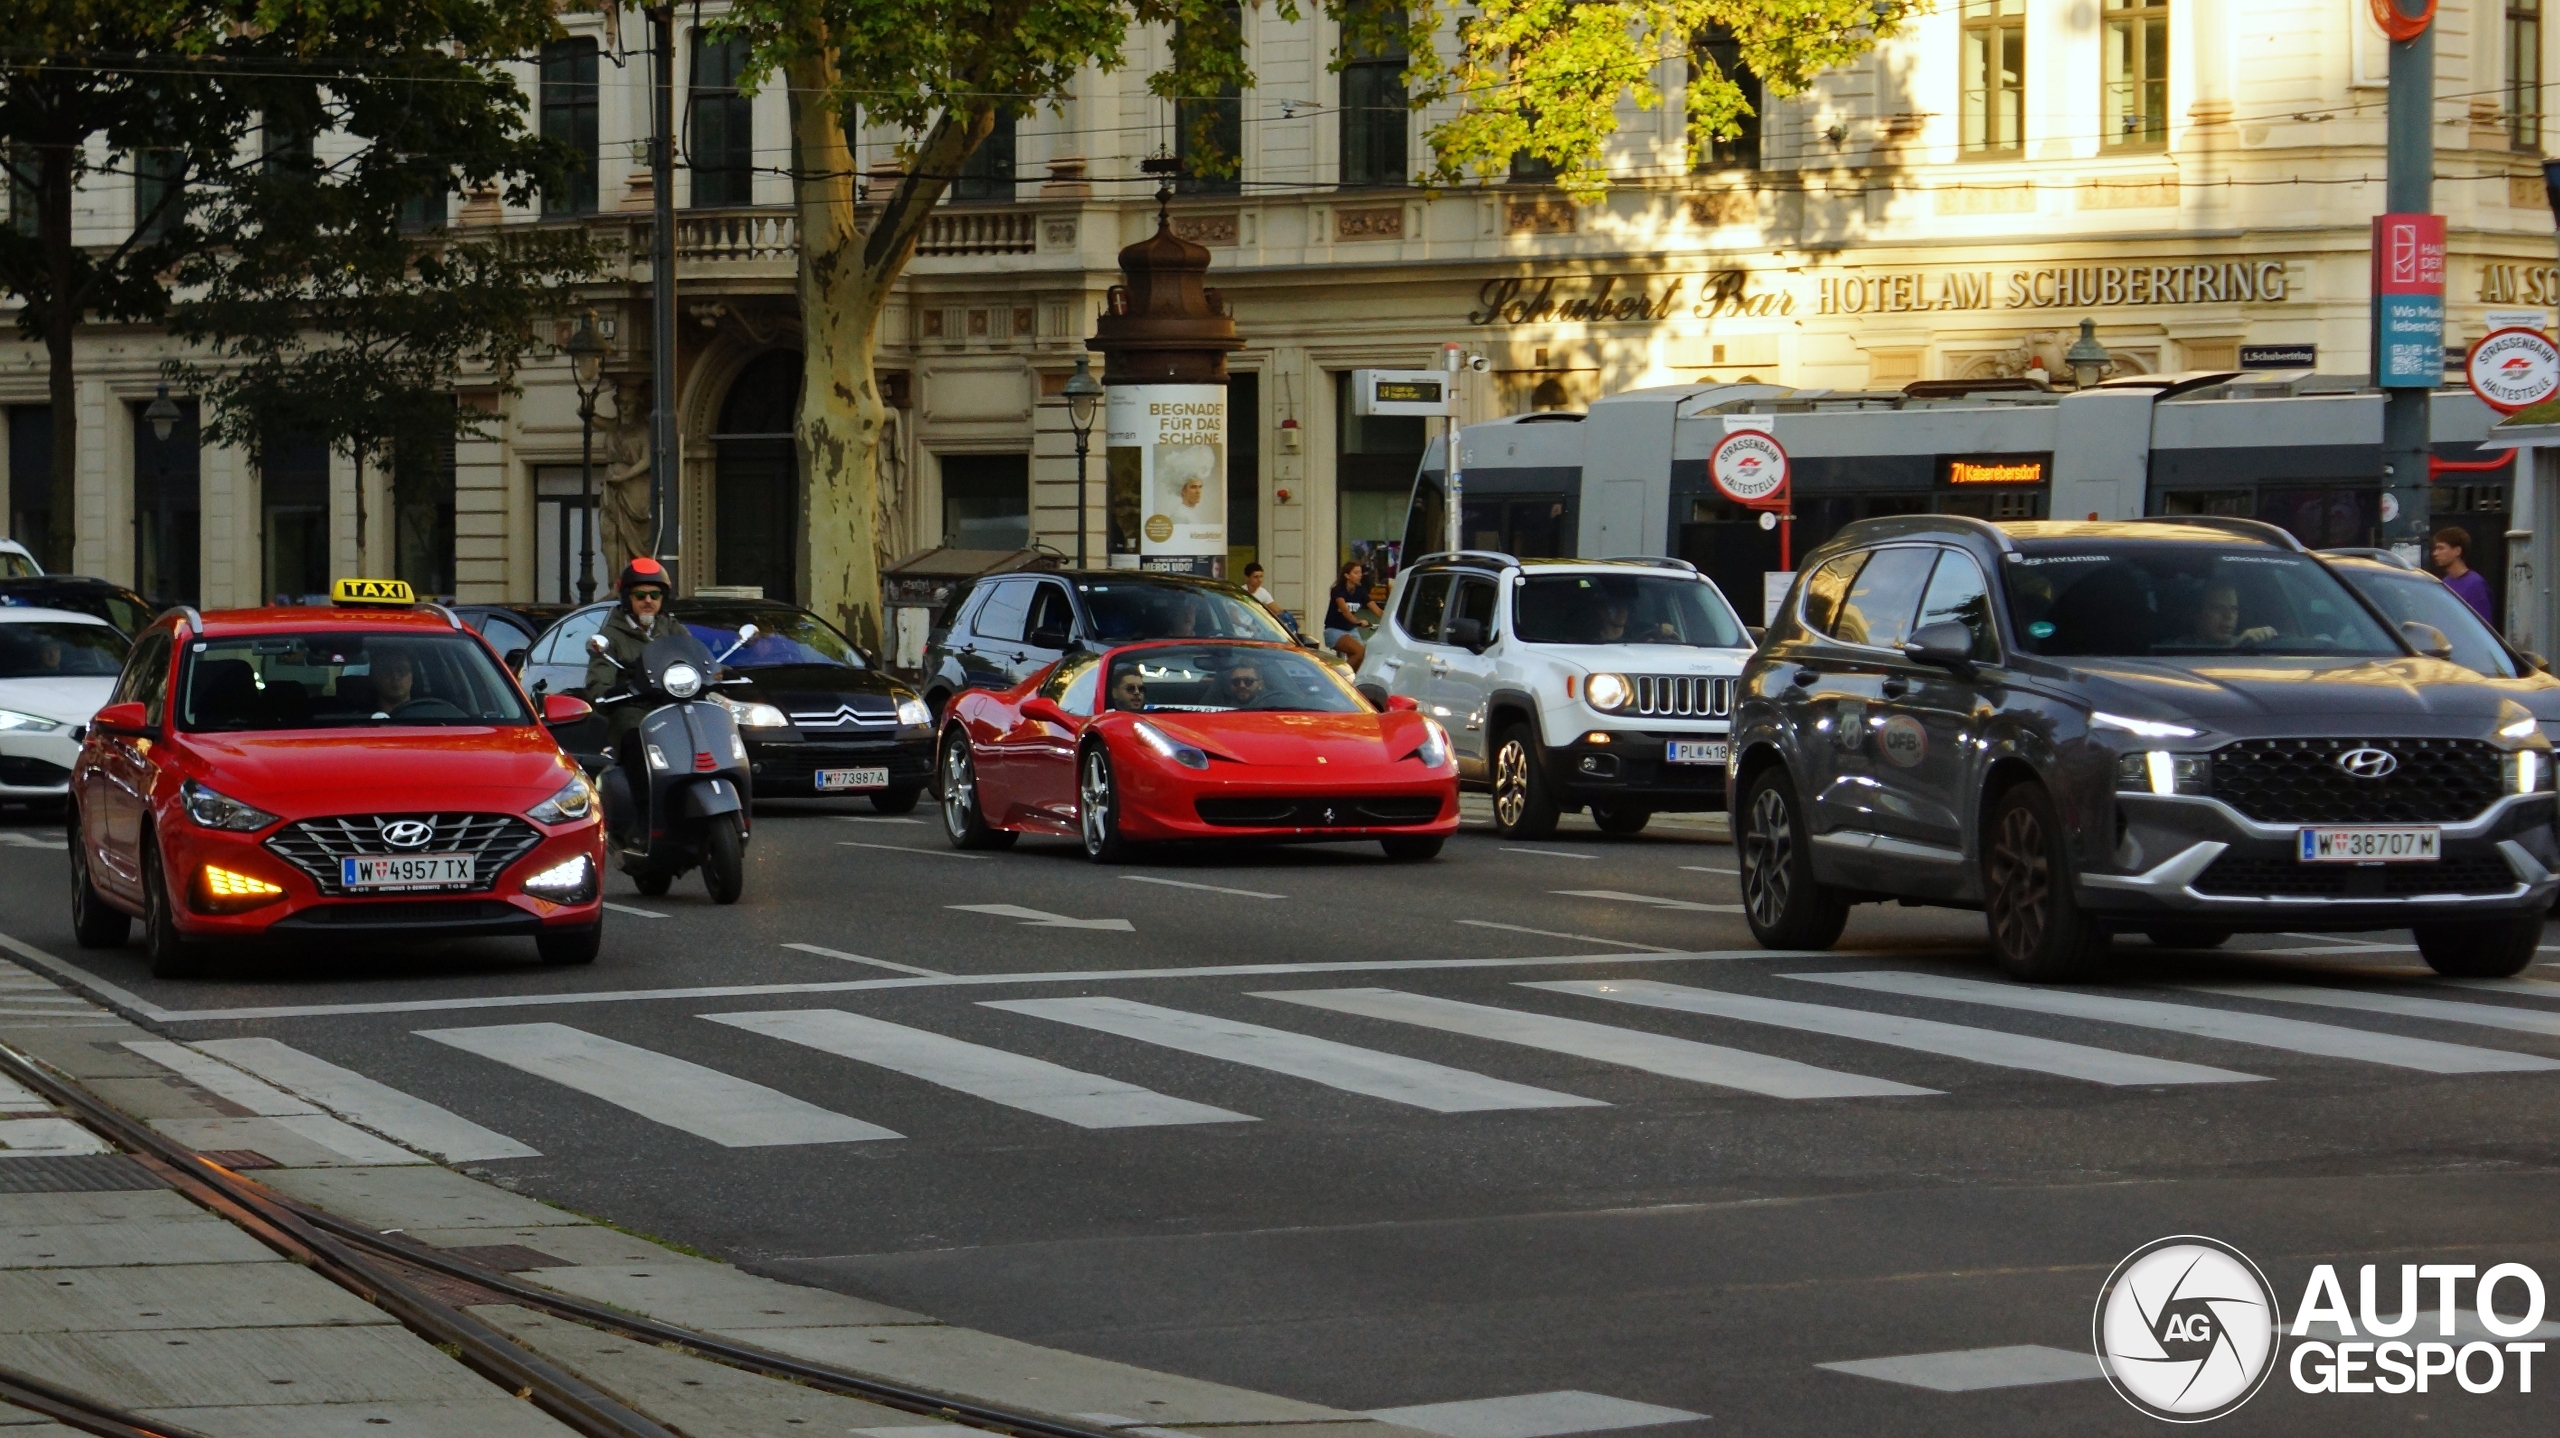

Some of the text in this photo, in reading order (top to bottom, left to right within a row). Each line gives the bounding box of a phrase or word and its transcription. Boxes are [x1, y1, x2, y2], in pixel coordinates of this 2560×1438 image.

[2421, 257, 2443, 270] DER
[1815, 261, 2288, 314] HOTEL AM SCHUBERTRING
[2481, 264, 2519, 303] AM
[1470, 270, 1797, 325] Schubert Bar
[2391, 305, 2416, 317] Wo
[2479, 337, 2556, 365] STRASSENBAHN
[2482, 376, 2553, 400] HALTESTELLE
[1160, 417, 1221, 430] FÜR DAS
[1159, 432, 1219, 445] SCHÖNE
[1720, 439, 1780, 462] STRASSENBAHN
[1951, 462, 2040, 483] 71 Kaiserebersdorf
[1722, 474, 1777, 494] HALTESTELLE
[1765, 516, 1772, 526] 2
[1142, 562, 1194, 572] MERCI UDO!
[345, 582, 404, 598] TAXI
[1681, 746, 1727, 758] PL 418
[2319, 835, 2333, 855] W
[2350, 834, 2415, 855] 38707
[359, 862, 374, 881] W
[390, 860, 438, 880] 4957
[445, 859, 469, 878] TX
